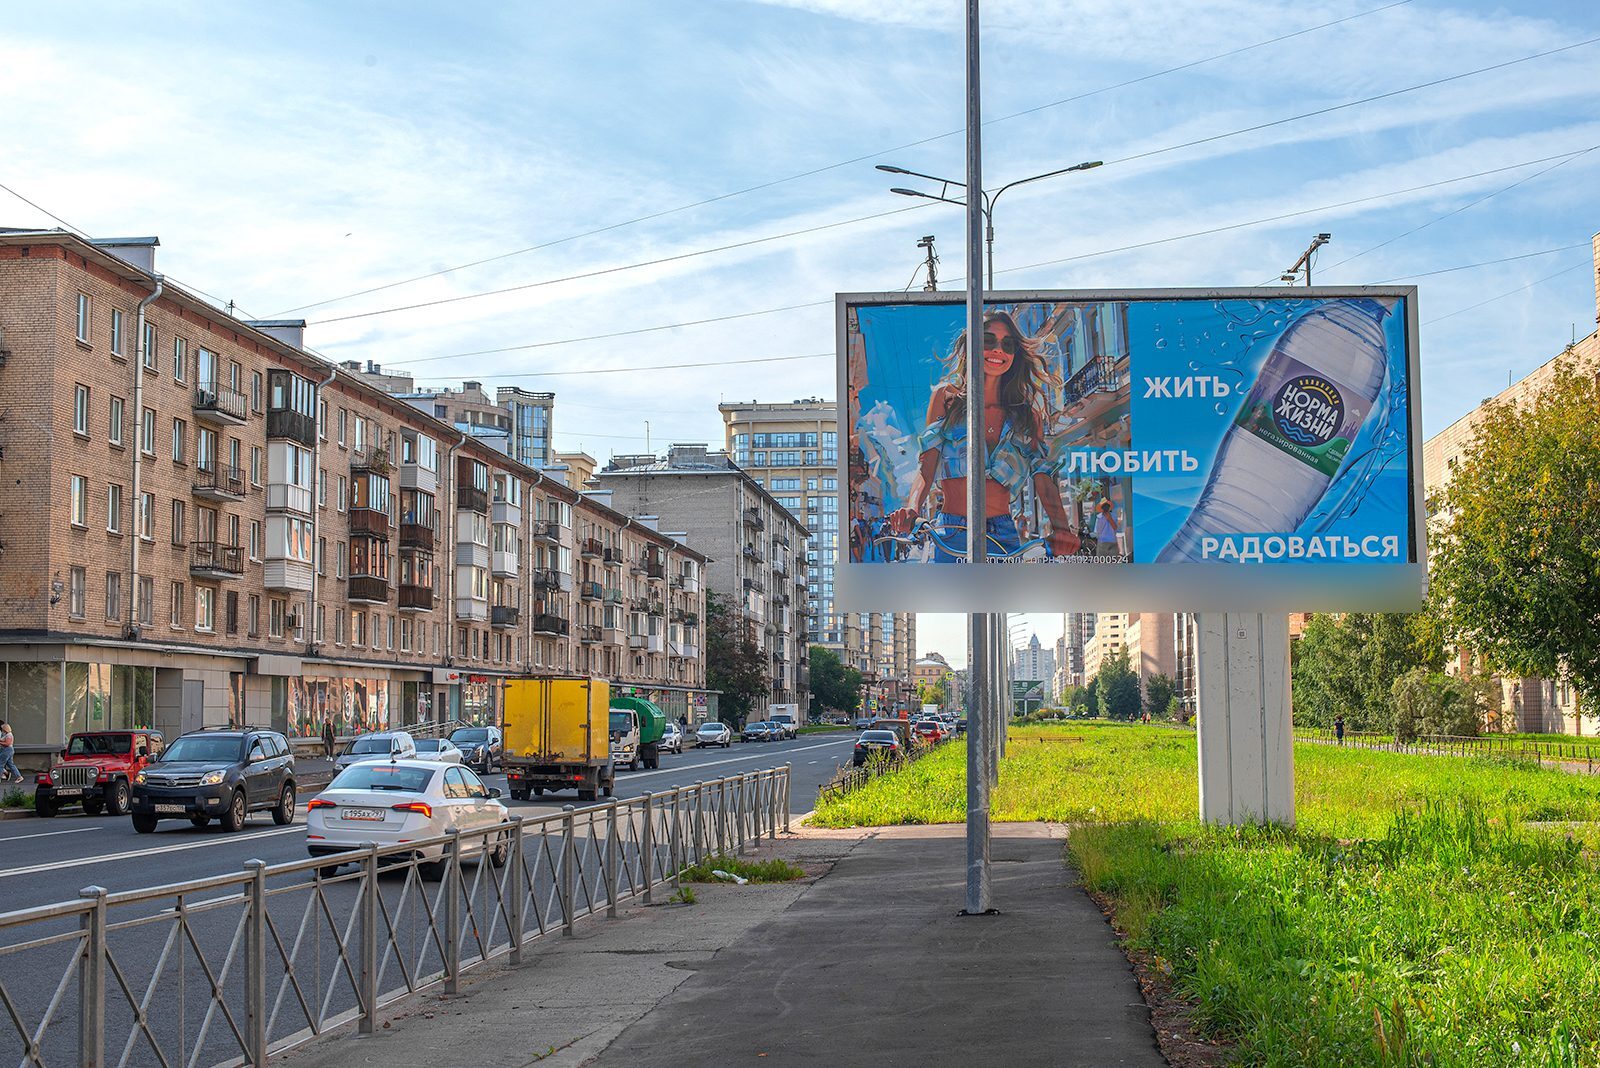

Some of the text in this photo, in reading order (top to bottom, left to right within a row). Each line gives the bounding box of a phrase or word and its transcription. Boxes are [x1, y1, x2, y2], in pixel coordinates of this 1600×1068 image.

[1143, 376, 1230, 398] ЖИТЬ
[1275, 399, 1335, 441] ЖИЗНИ
[1283, 384, 1339, 426] НОРМА
[1258, 426, 1319, 464] негазированная
[1067, 450, 1199, 474] ЛЮБИТЬ
[1201, 534, 1400, 561] РАДОВАТЬСЯ
